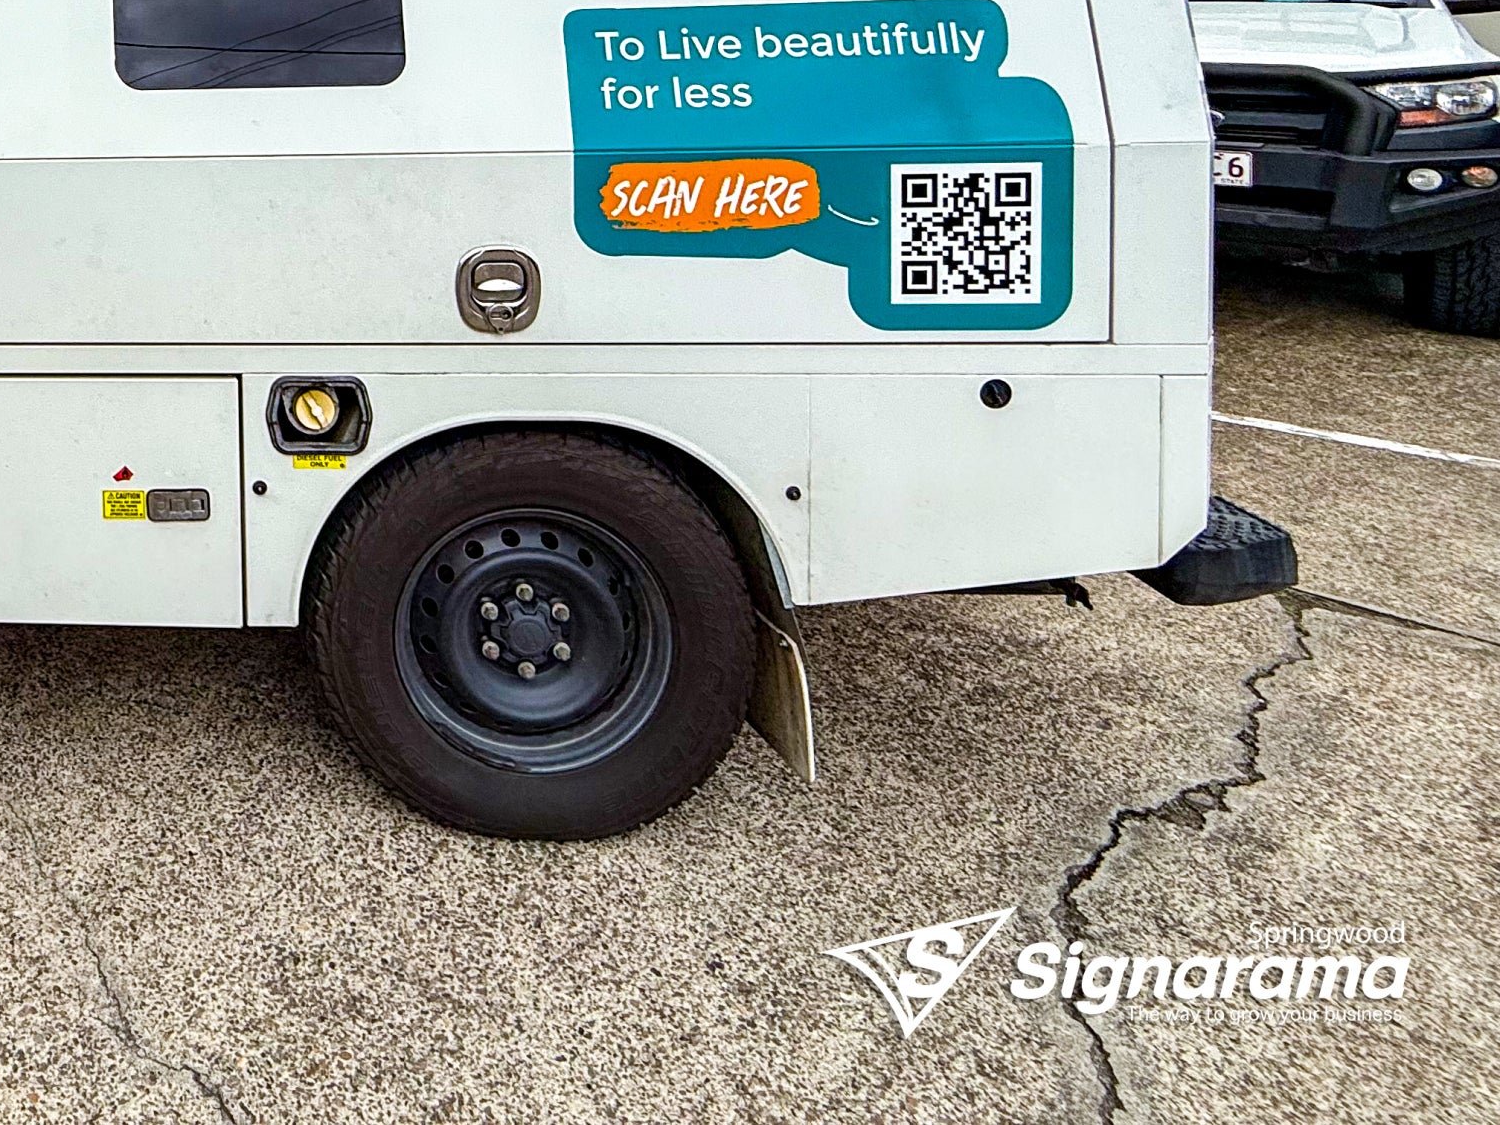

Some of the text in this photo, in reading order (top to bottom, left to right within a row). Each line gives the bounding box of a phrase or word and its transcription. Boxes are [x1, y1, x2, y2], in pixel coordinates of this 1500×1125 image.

[595, 22, 986, 63] To Live beautifully
[601, 76, 753, 110] for less
[611, 174, 808, 219] SCAN HERE
[115, 492, 141, 500] CAUTION
